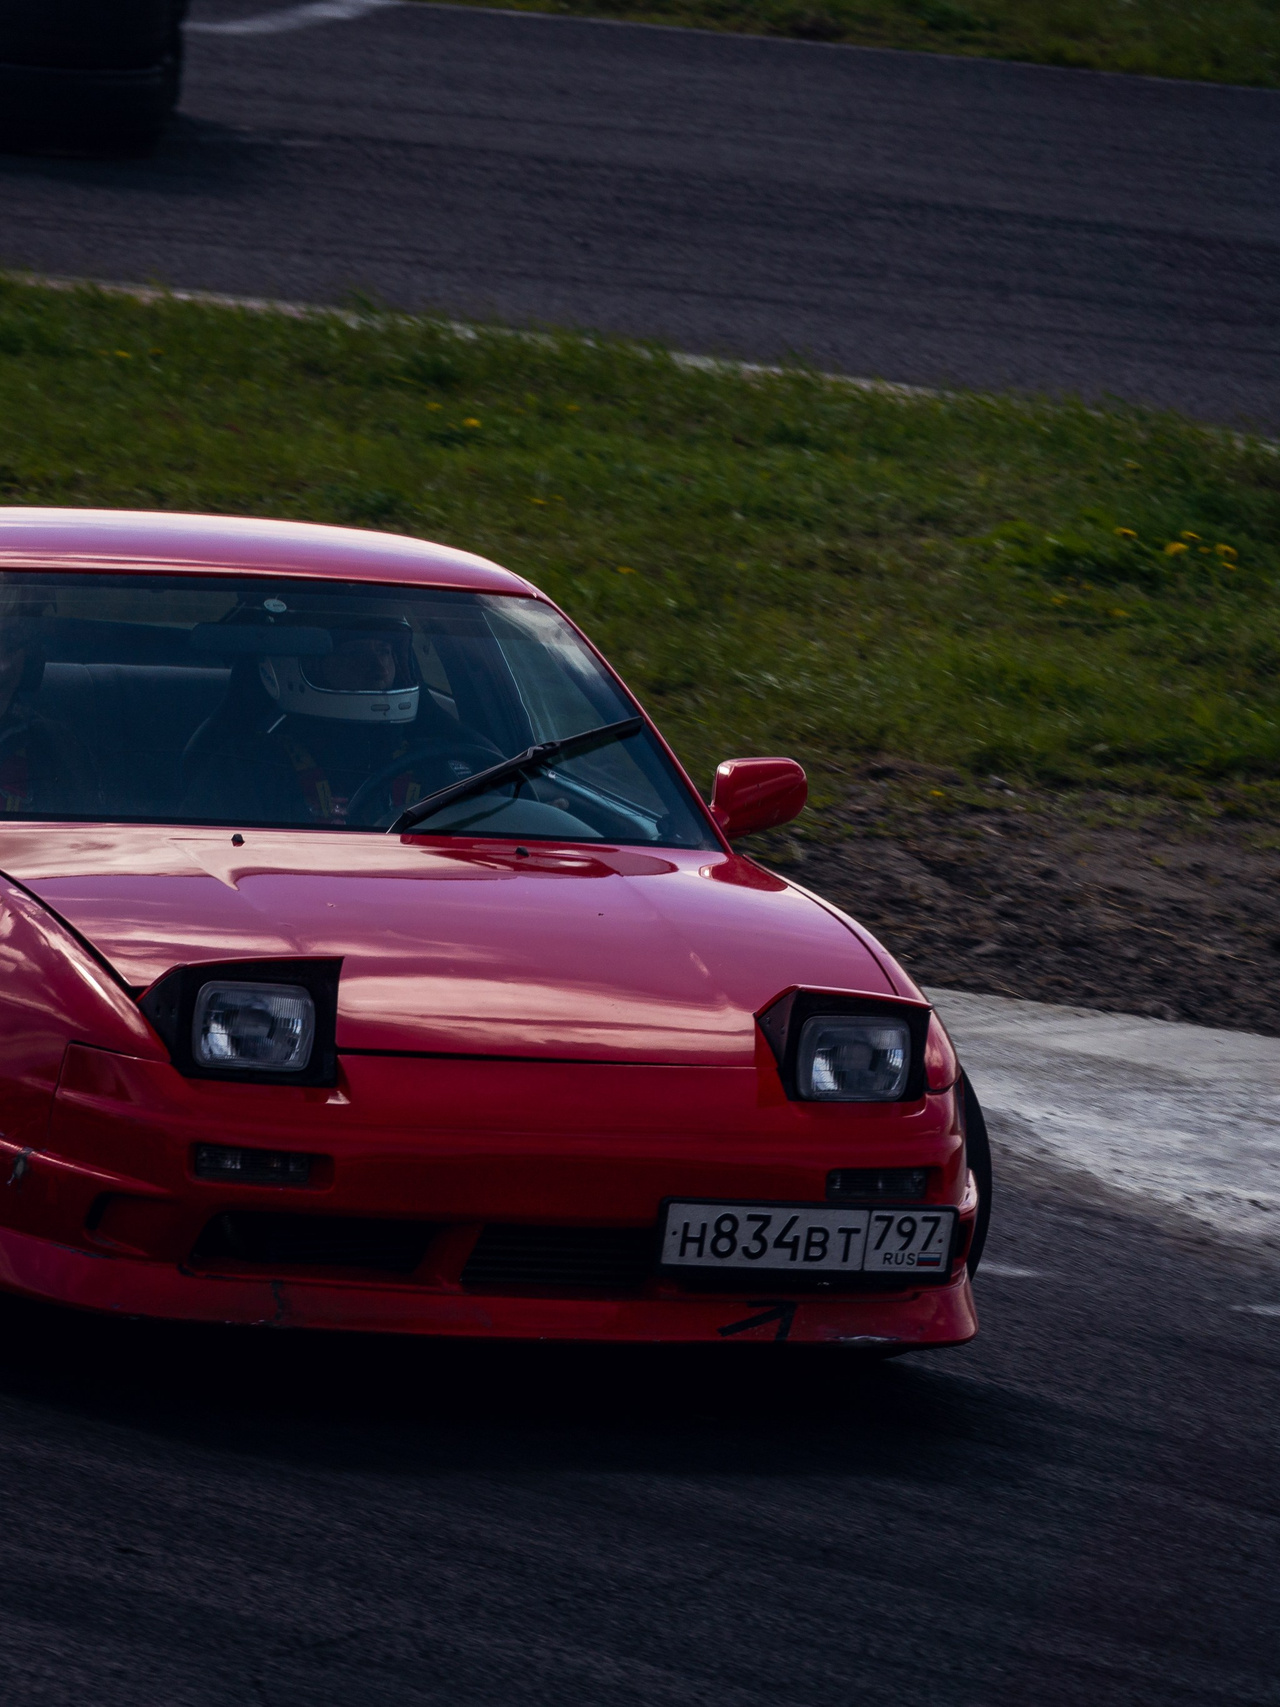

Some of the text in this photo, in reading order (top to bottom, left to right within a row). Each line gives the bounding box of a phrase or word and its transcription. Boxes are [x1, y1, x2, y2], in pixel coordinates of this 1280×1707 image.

[679, 1213, 940, 1262] Н834ВТ 797
[883, 1252, 916, 1266] RUS
